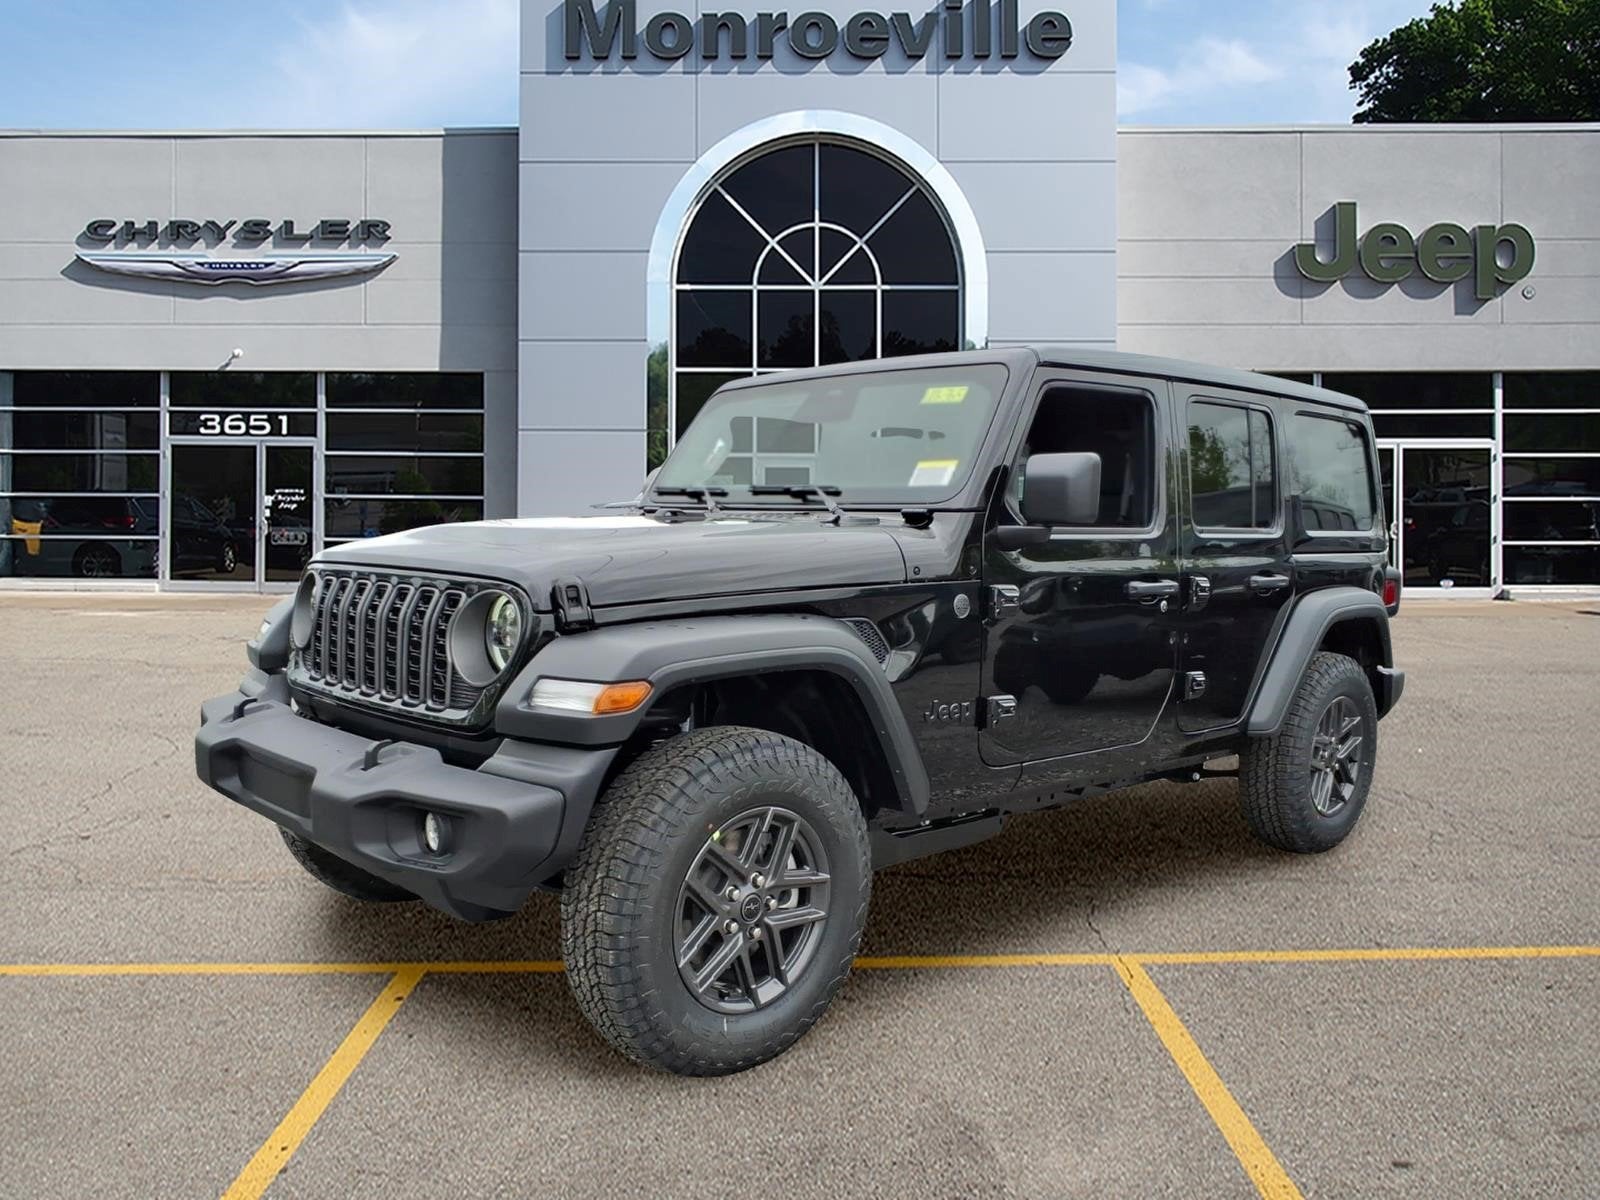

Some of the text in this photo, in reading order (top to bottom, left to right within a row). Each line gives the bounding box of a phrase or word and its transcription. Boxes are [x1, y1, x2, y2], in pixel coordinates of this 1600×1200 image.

[563, 0, 1073, 60] Monroeville
[85, 219, 391, 241] CHRYSLER
[1294, 201, 1536, 300] Jeep
[199, 413, 288, 435] 3651
[923, 699, 972, 722] Jeep
